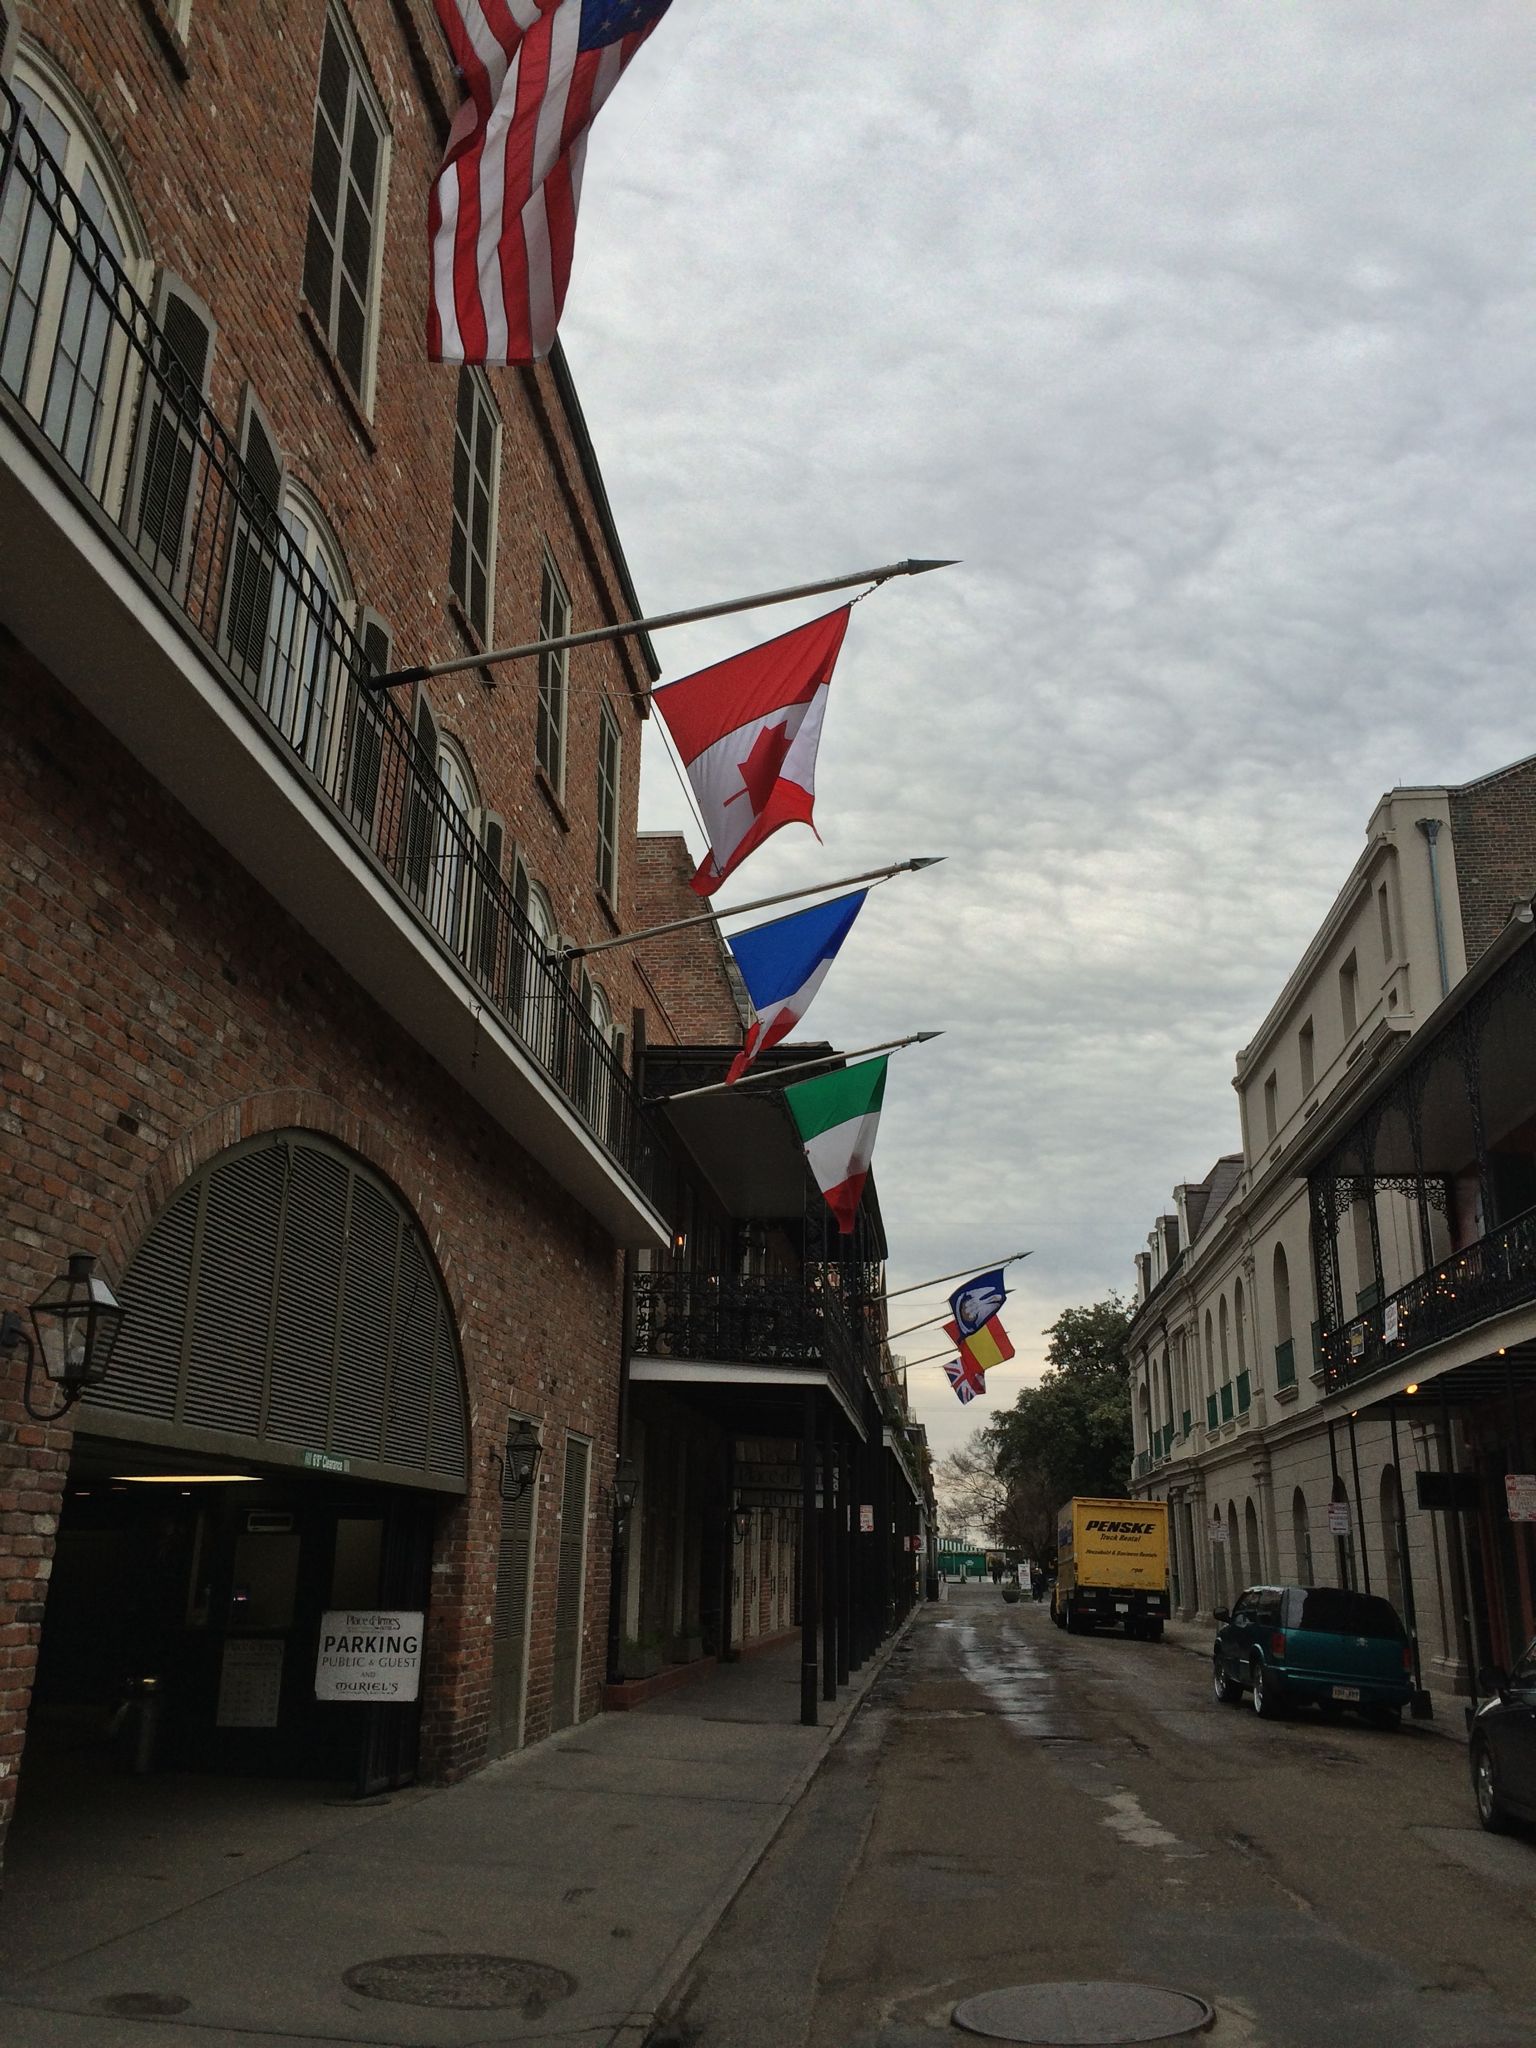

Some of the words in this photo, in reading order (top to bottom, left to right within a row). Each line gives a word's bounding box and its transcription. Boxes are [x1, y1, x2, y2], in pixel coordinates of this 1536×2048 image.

[1085, 1520, 1156, 1535] PENSKE
[1100, 1533, 1118, 1541] Truck
[1118, 1534, 1142, 1543] Rental
[323, 1636, 418, 1653] PARKING
[321, 1656, 366, 1668] PUBLIC
[378, 1657, 417, 1668] GUEST
[335, 1682, 399, 1693] MURIEL'S
